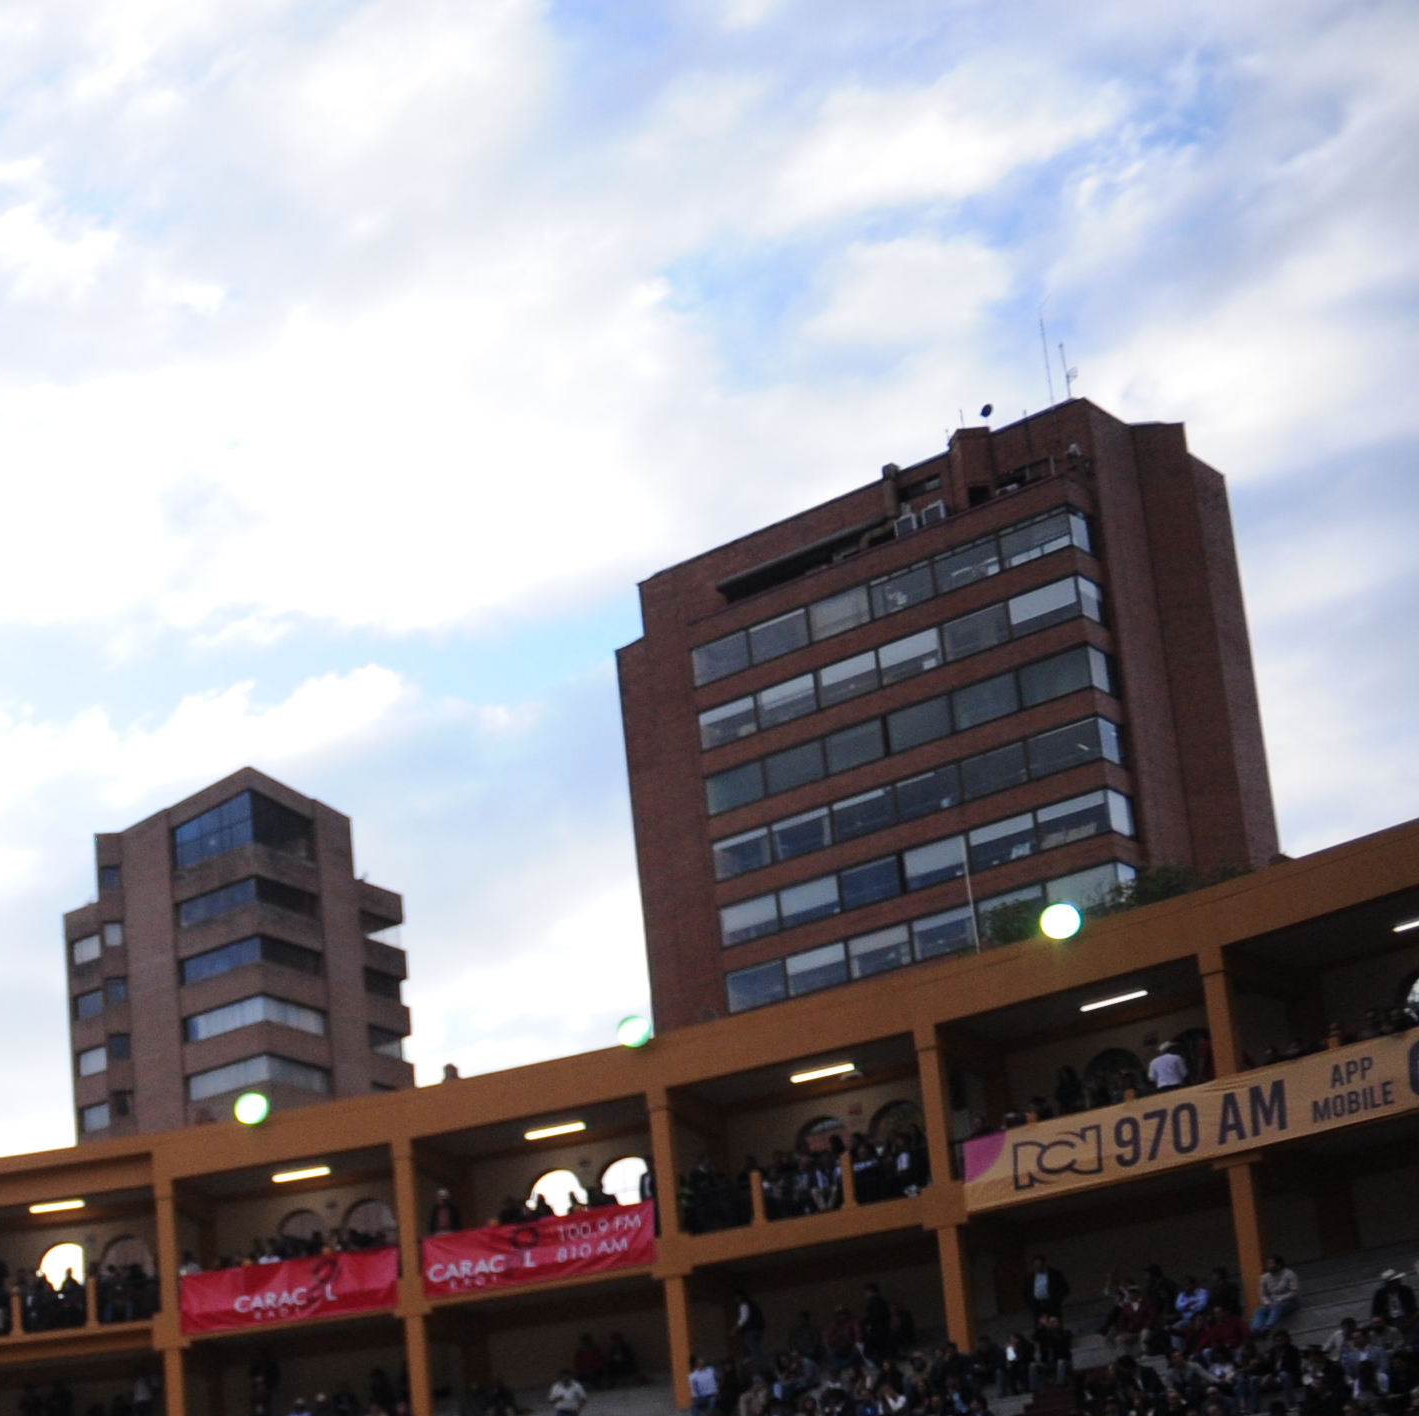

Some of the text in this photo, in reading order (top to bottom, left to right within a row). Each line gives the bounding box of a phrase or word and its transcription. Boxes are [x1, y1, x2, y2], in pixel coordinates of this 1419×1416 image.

[1331, 1056, 1374, 1089] APP
[1312, 1080, 1396, 1123] MOBILE
[1113, 1102, 1199, 1168] 970
[1218, 1080, 1288, 1146] AM
[557, 1214, 642, 1241] 100.9 FM
[557, 1237, 628, 1263] 810 AM
